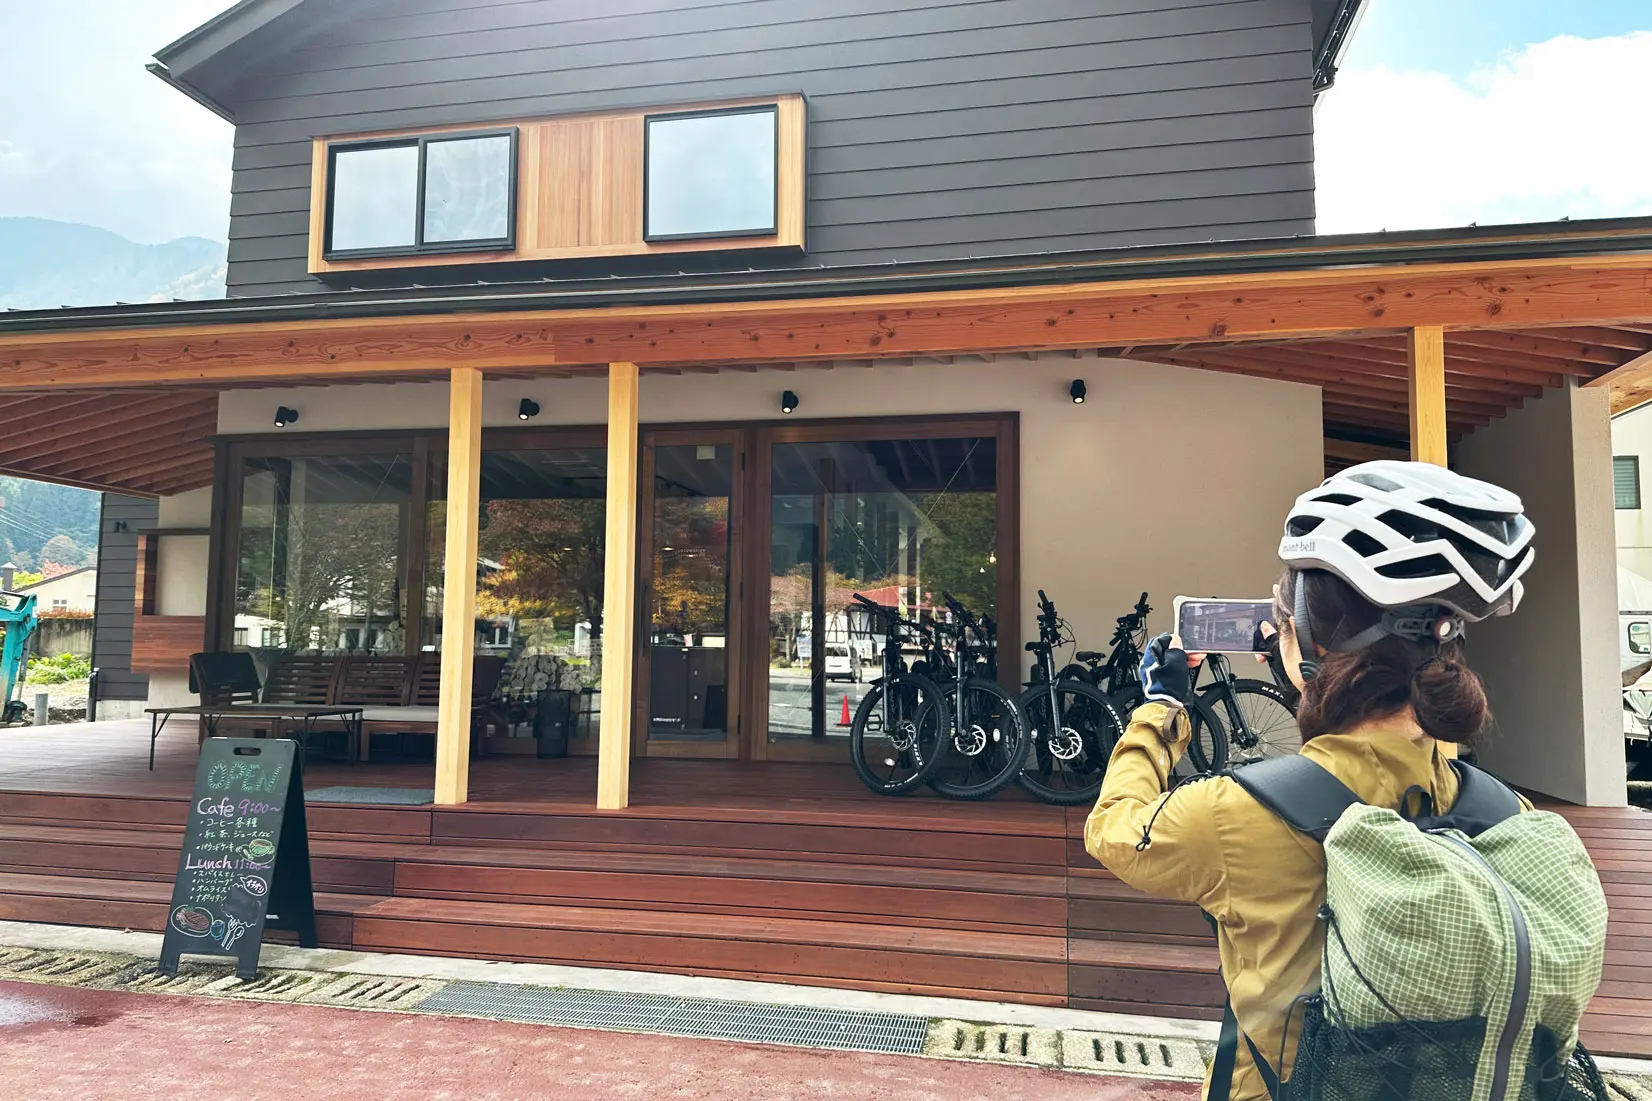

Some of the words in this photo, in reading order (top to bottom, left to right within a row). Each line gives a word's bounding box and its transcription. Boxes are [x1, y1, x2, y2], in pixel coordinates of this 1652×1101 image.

[207, 760, 284, 793] OPEN
[196, 797, 235, 817] Cafe
[185, 853, 233, 870] Lunch
